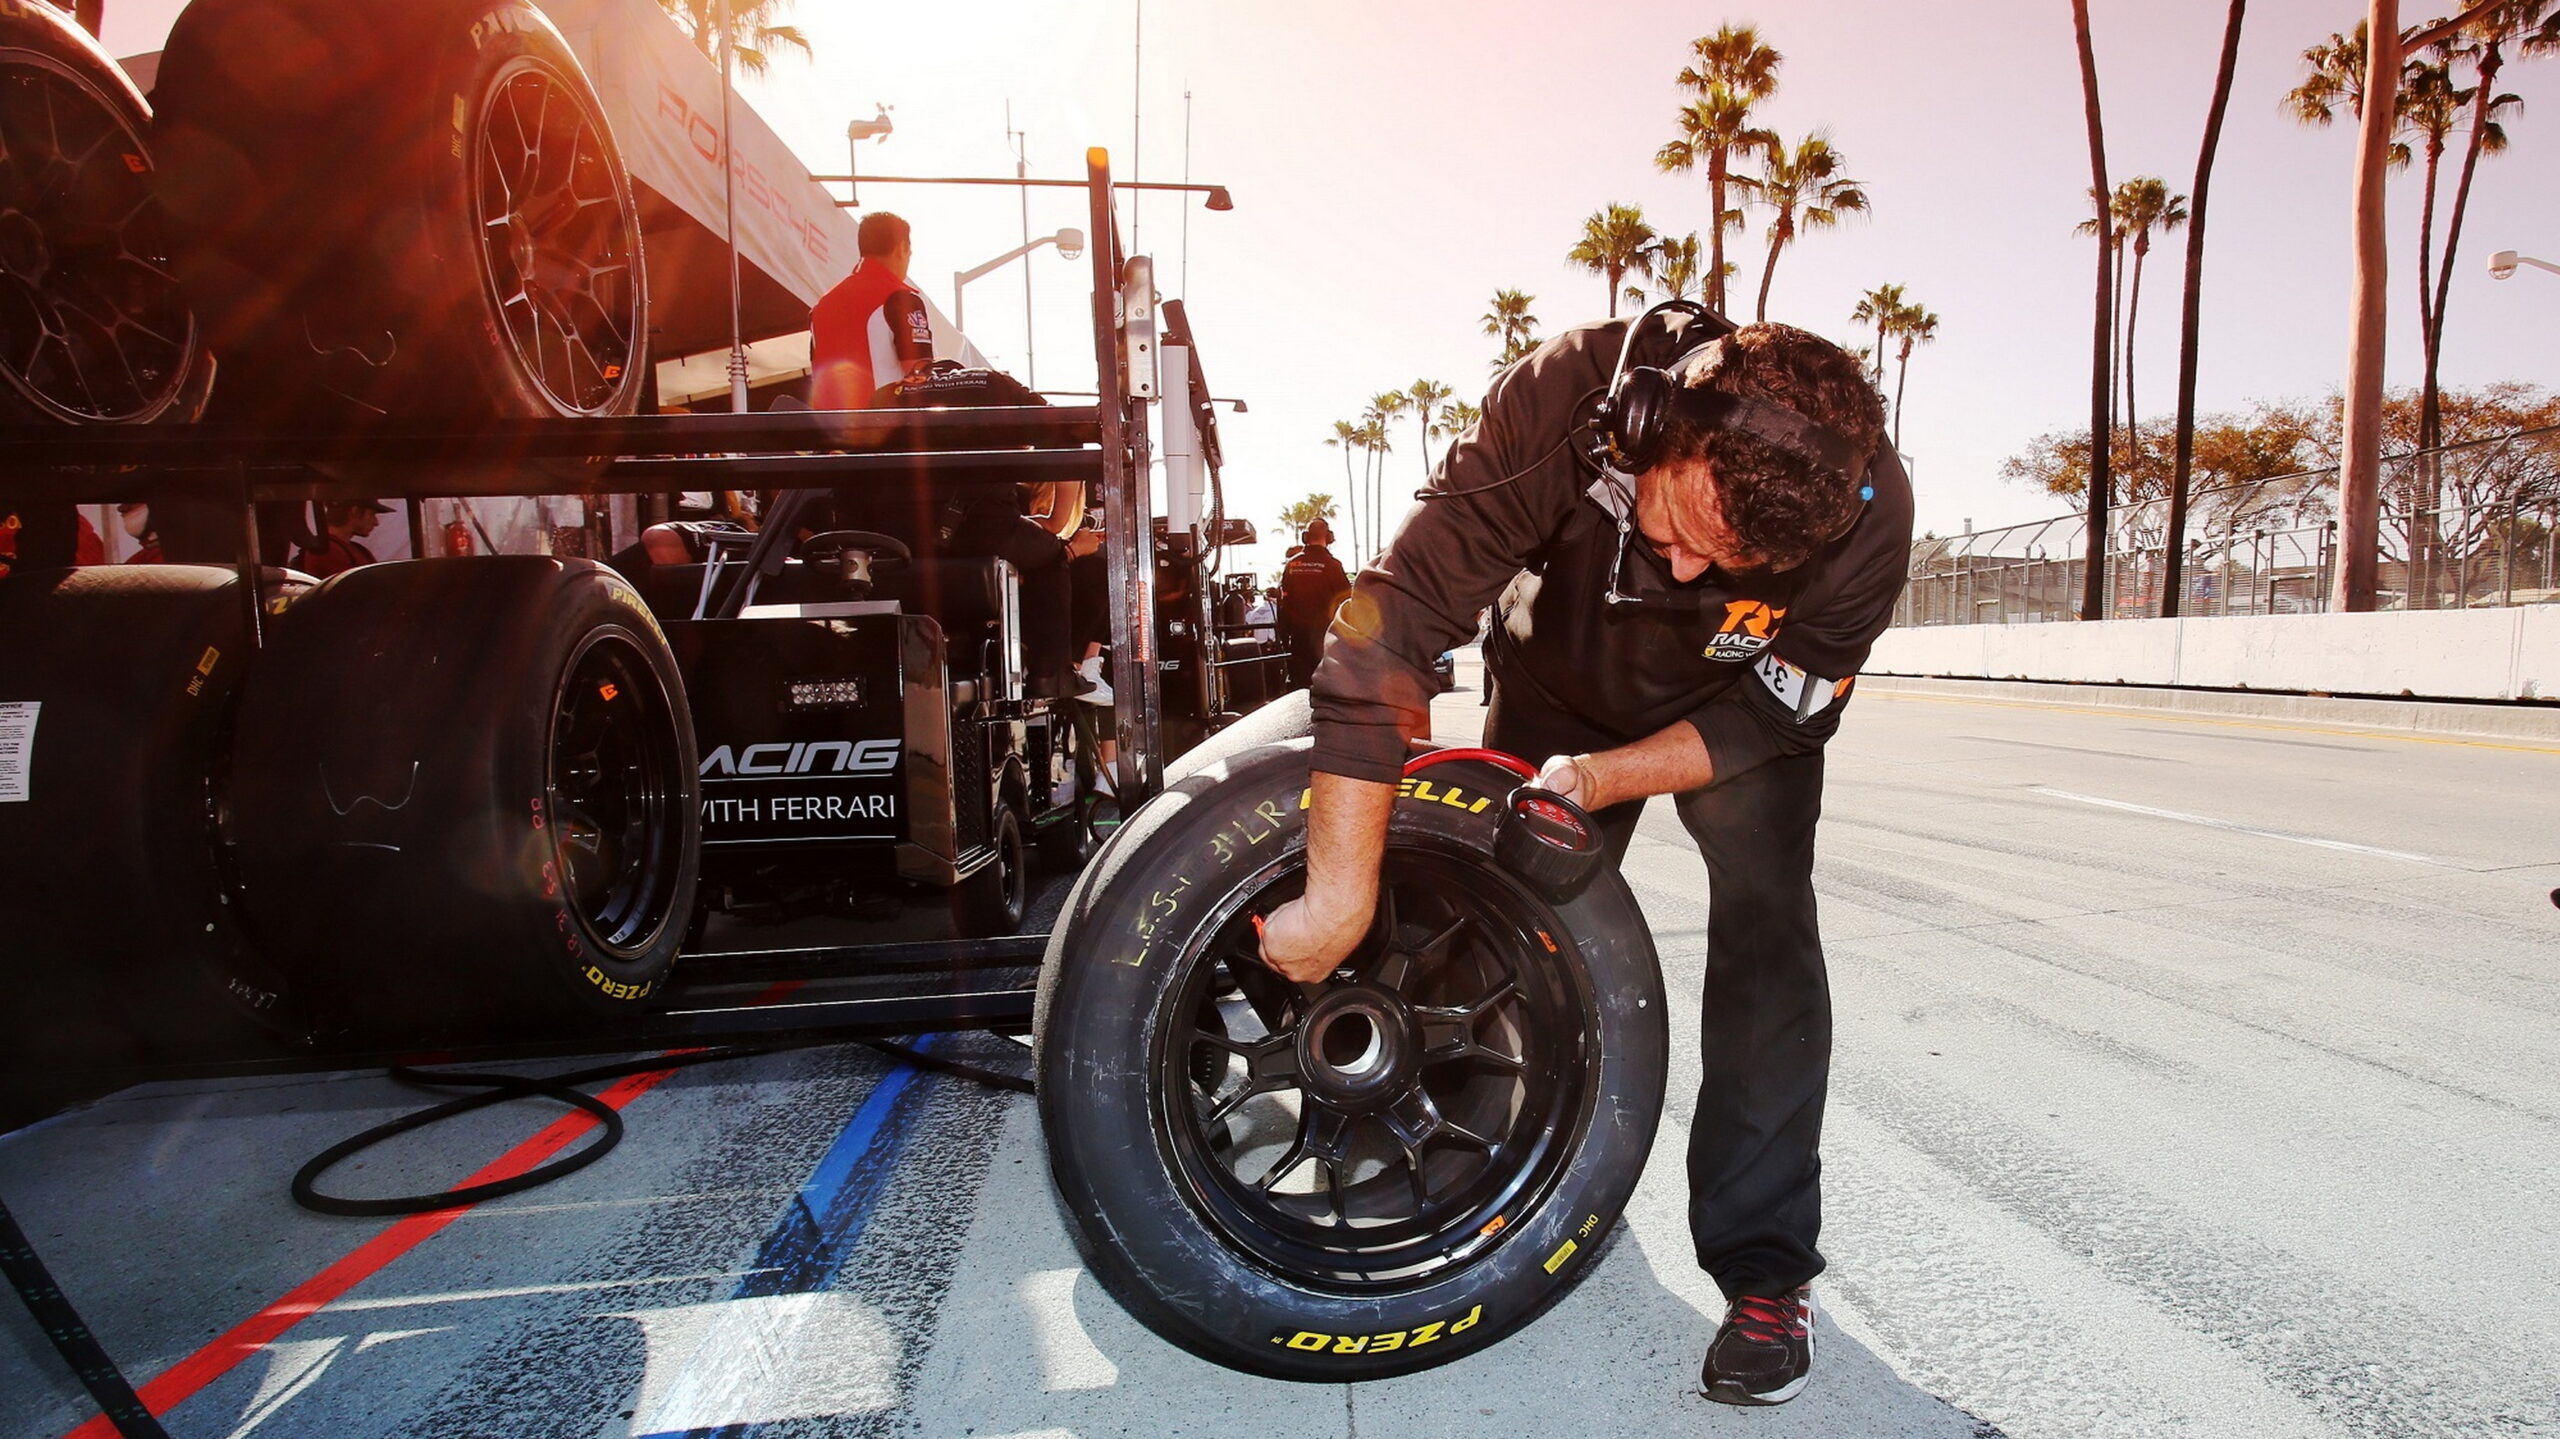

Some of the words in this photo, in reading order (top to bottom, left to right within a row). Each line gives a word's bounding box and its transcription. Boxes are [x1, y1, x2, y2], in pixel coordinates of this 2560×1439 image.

[656, 82, 829, 263] PORSCHE
[612, 587, 666, 646] PIRELLI
[1715, 650, 1744, 658] RACING
[1762, 653, 1789, 693] 31
[186, 675, 204, 697] DHC
[771, 794, 895, 821] FERRARI
[1232, 799, 1287, 845] LR
[585, 965, 652, 1001] PZERO
[1578, 1213, 1599, 1238] DHC
[1286, 1303, 1483, 1354] PZERO
